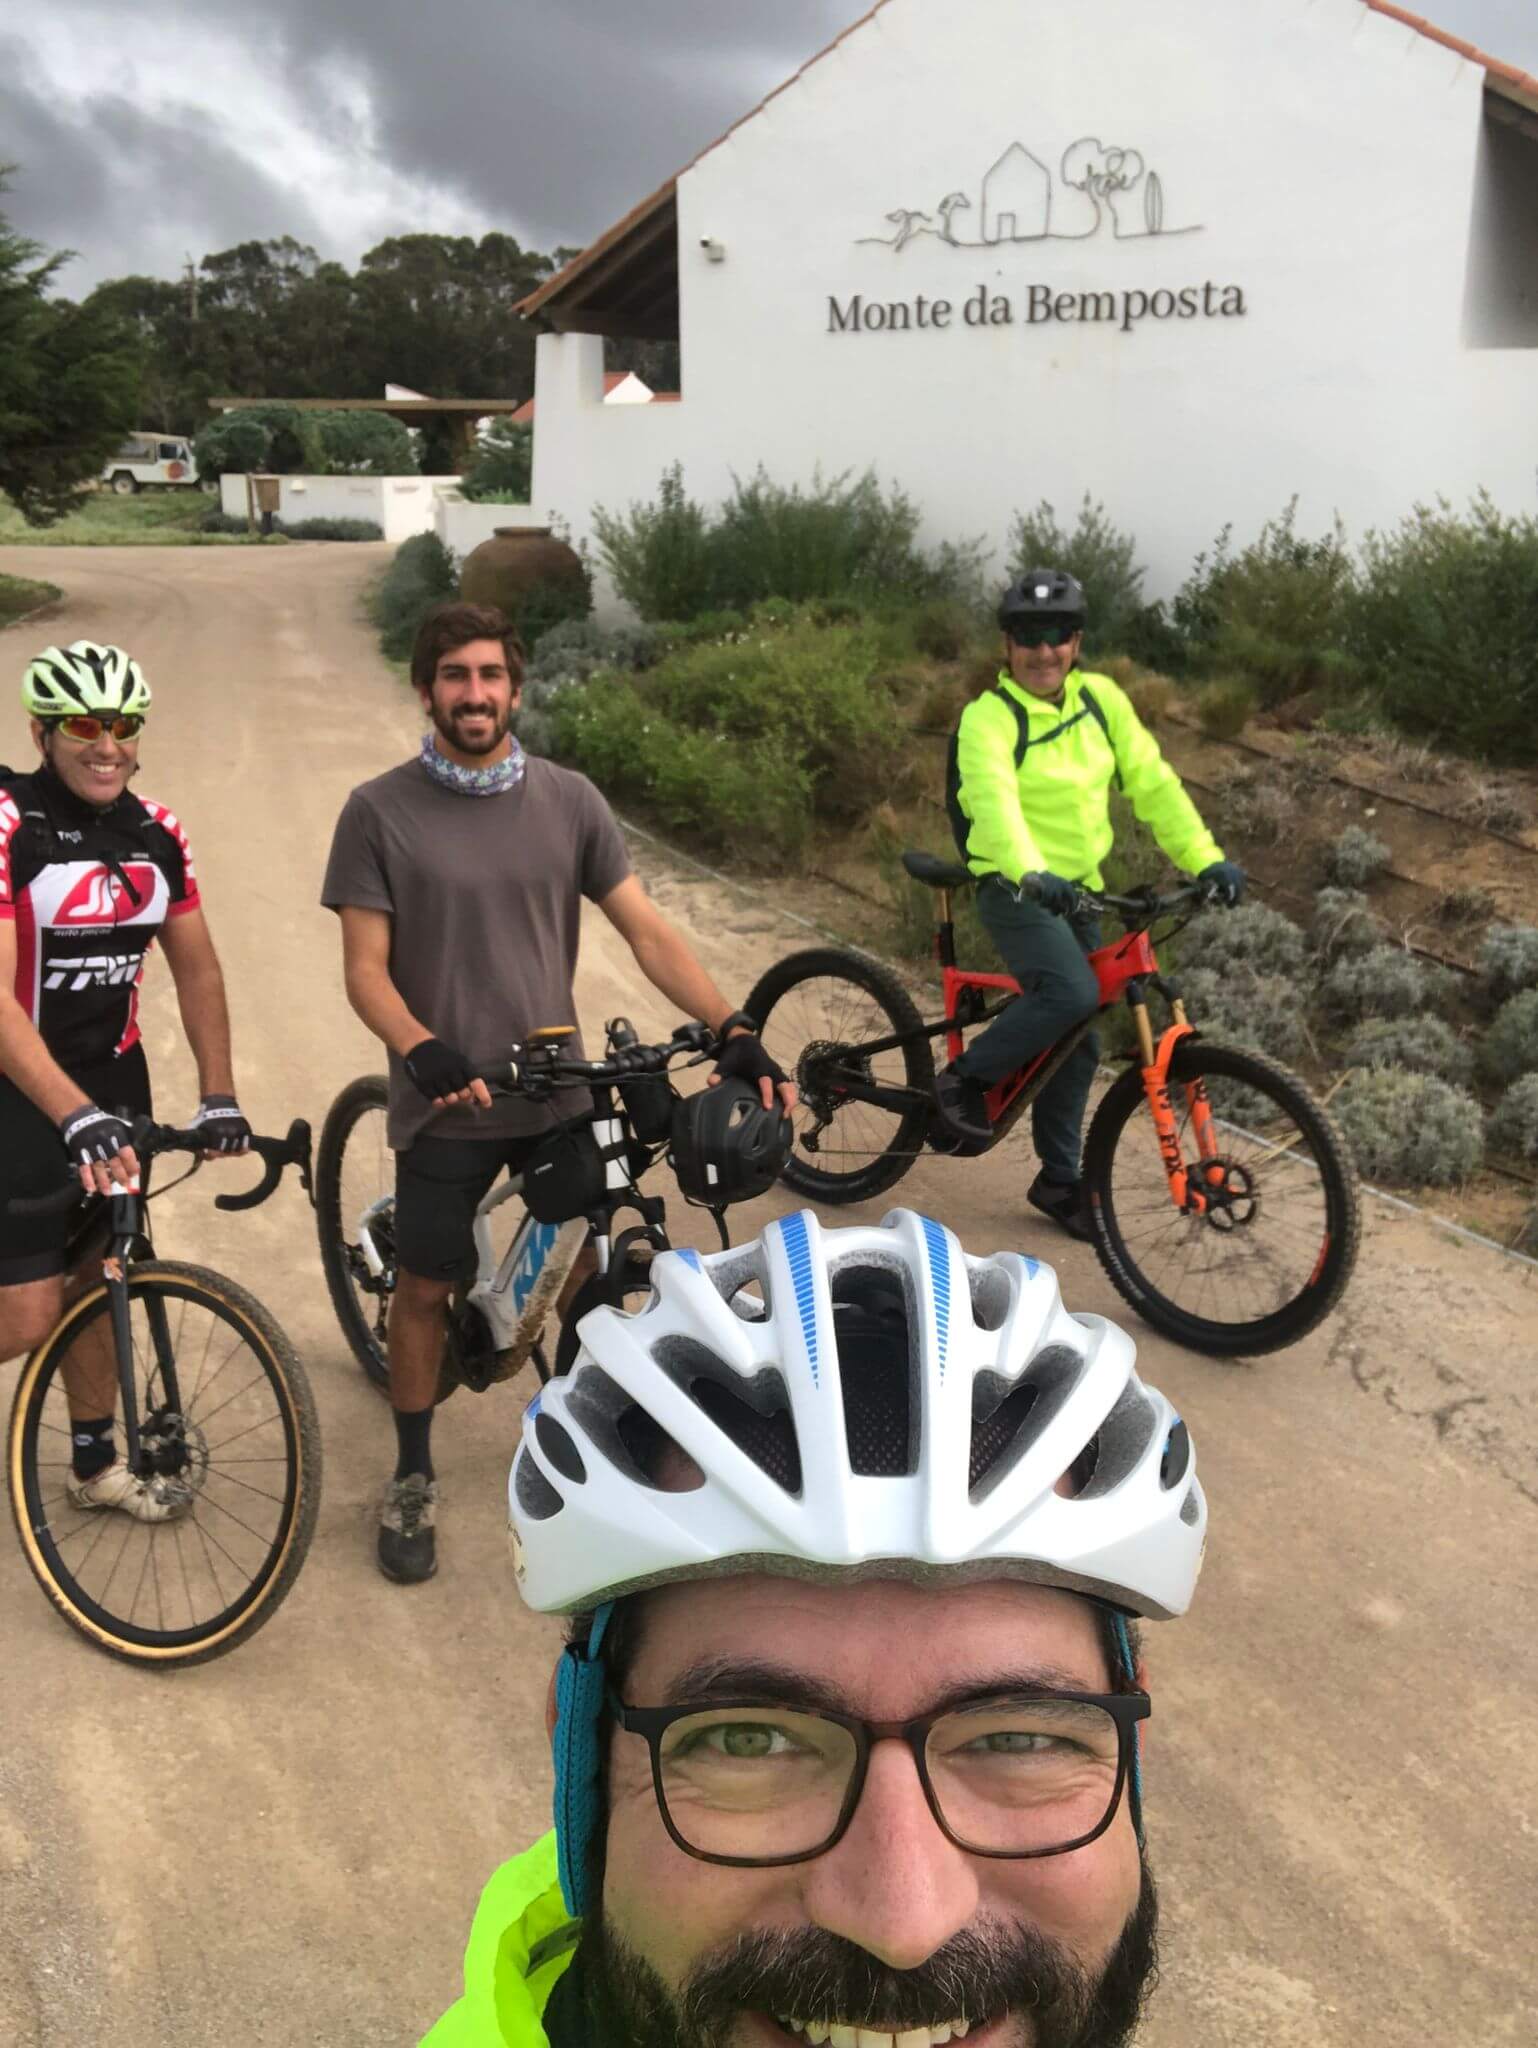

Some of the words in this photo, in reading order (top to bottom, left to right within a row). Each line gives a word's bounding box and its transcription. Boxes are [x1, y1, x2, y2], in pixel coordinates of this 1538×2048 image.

[826, 294, 952, 332] Monte
[962, 285, 1013, 326] da
[1025, 280, 1247, 331] Bemposta
